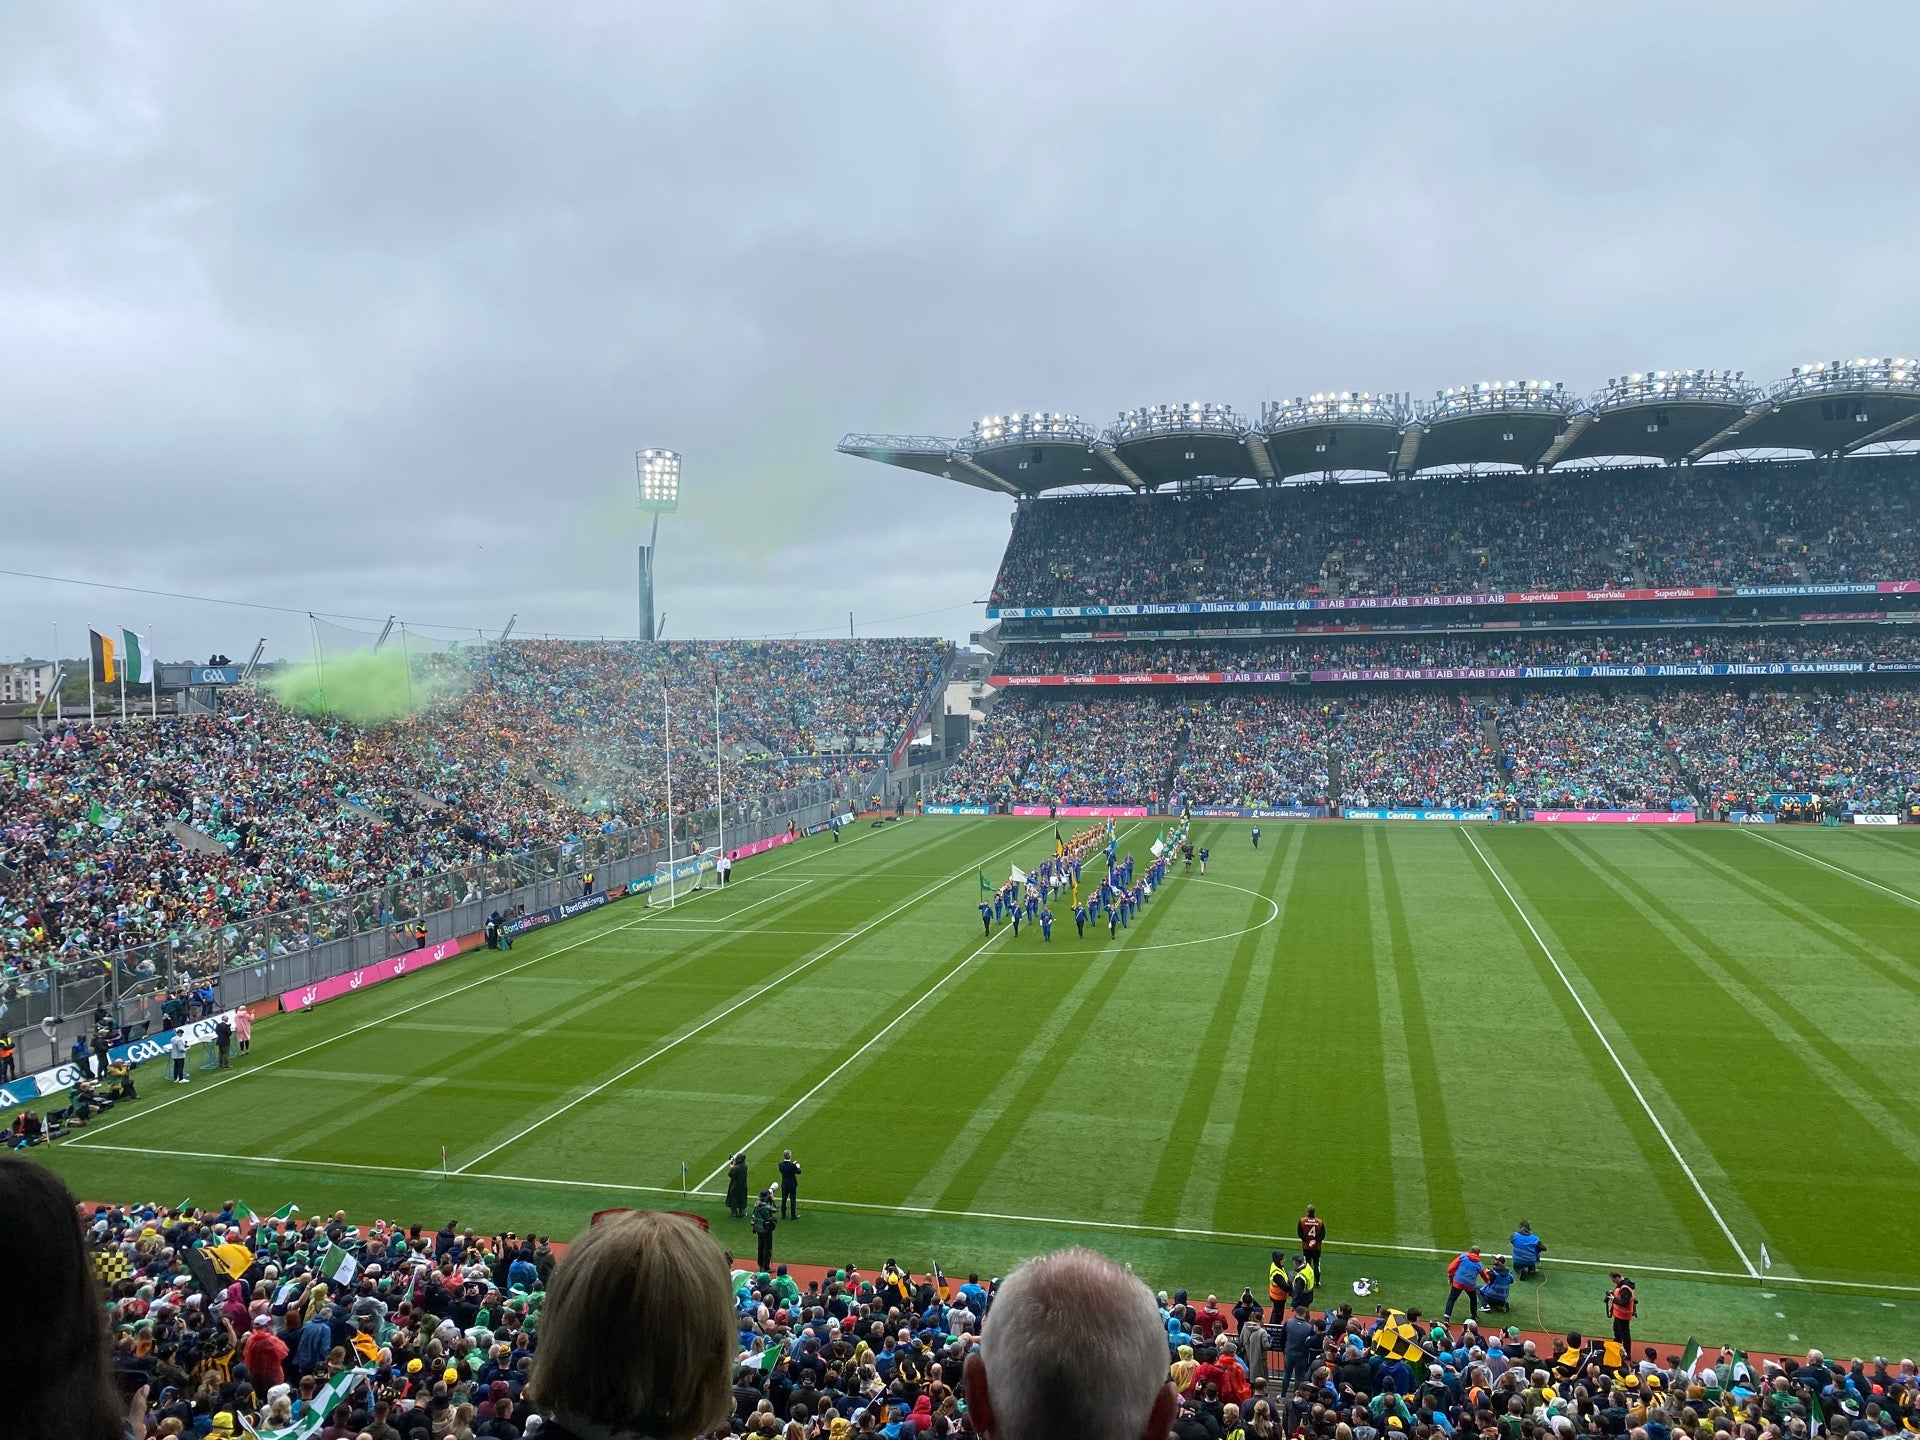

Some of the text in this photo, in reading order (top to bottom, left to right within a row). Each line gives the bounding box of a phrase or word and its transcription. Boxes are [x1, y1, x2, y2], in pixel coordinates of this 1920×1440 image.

[1758, 587, 1797, 595] MUSEUM
[1807, 585, 1849, 593] STADIUM
[1520, 594, 1558, 602] SuperValu
[1586, 592, 1625, 600] SuperValu
[1654, 590, 1694, 599] SuperValu
[1360, 599, 1377, 607] AIB
[1391, 598, 1408, 606] AIB
[1423, 597, 1440, 605] AIB
[1455, 596, 1473, 604] AIB
[1487, 595, 1505, 603] AIB
[1200, 603, 1235, 612] Allianz
[1260, 601, 1295, 610] Allianz
[1328, 600, 1345, 608] AIB
[1003, 609, 1019, 617] GAA
[1030, 608, 1047, 616] GAA
[1058, 607, 1075, 616] GAA
[1086, 607, 1103, 615] GAA
[1114, 606, 1131, 614] GAA
[1142, 605, 1176, 614] Allianz
[1591, 667, 1629, 676] Allianz
[1658, 666, 1697, 675] Allianz
[1727, 665, 1767, 674] Allianz
[1791, 663, 1862, 672] GAA MUSEUM
[202, 669, 226, 682] GAA
[1342, 672, 1358, 680] AIB
[1374, 671, 1390, 679] AIB
[1404, 671, 1421, 679] AIB
[1437, 670, 1453, 678] AIB
[1499, 669, 1515, 677] AIB
[1525, 668, 1563, 677] Allianz
[1008, 677, 1041, 685] SuperValu
[1118, 675, 1152, 683] SuperValu
[1175, 674, 1210, 683] SuperValu
[1264, 673, 1280, 681] AIB
[927, 806, 953, 815] Centra
[959, 807, 985, 815] Centra
[1218, 809, 1240, 818] Energy
[1290, 810, 1310, 818] Energy
[1350, 811, 1378, 819] Centra
[1387, 811, 1416, 819] Centra
[1424, 812, 1454, 820] Centra
[1462, 812, 1488, 820] Centr
[1864, 815, 1886, 823] GAA
[632, 879, 652, 892] Centra
[565, 902, 578, 914] Bord
[588, 896, 605, 906] Energy
[503, 921, 518, 934] Bord
[531, 913, 550, 926] Energy
[433, 944, 446, 961] eir
[394, 957, 406, 974] eir
[350, 971, 363, 988] eir
[302, 986, 317, 1005] eir
[127, 1040, 165, 1063] GAA
[56, 1065, 86, 1086] GA
[1308, 1226, 1316, 1238] 4
